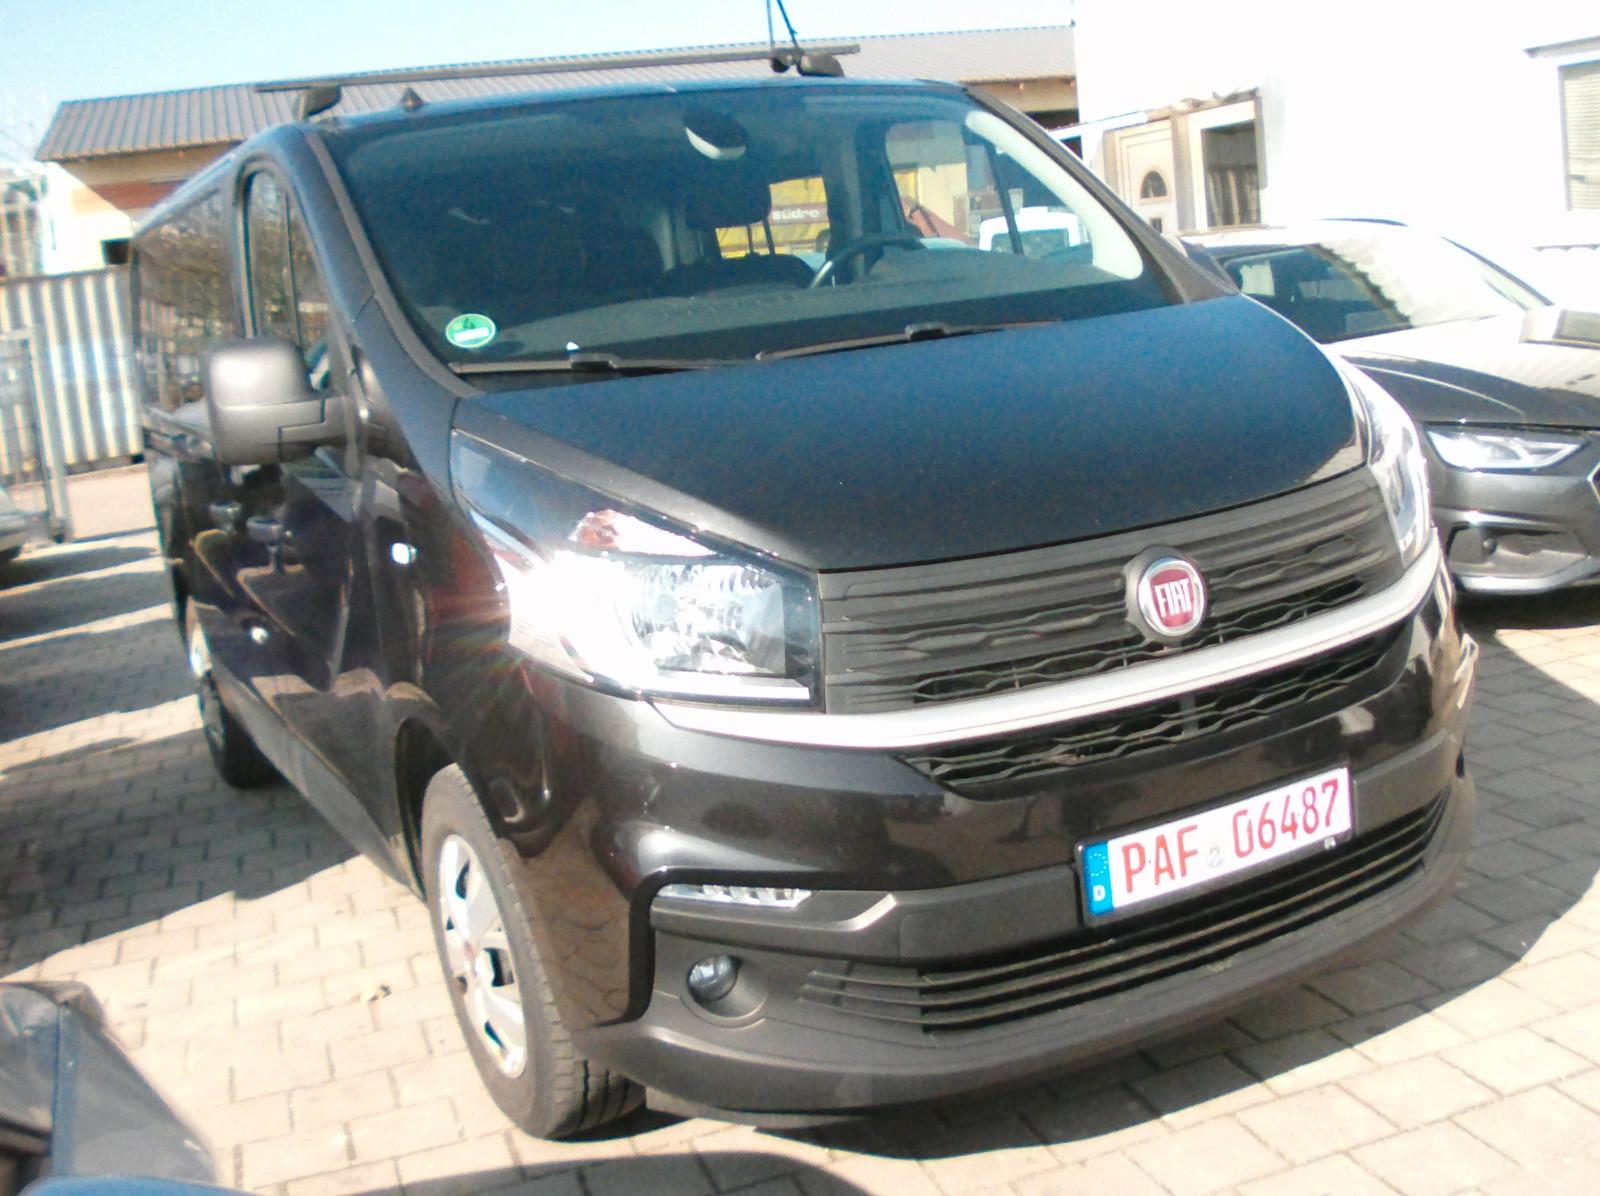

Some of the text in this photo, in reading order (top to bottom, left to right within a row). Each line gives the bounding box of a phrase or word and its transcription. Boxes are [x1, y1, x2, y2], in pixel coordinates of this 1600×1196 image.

[1155, 578, 1192, 618] FIAT
[1093, 778, 1338, 901] D PAF 06487
